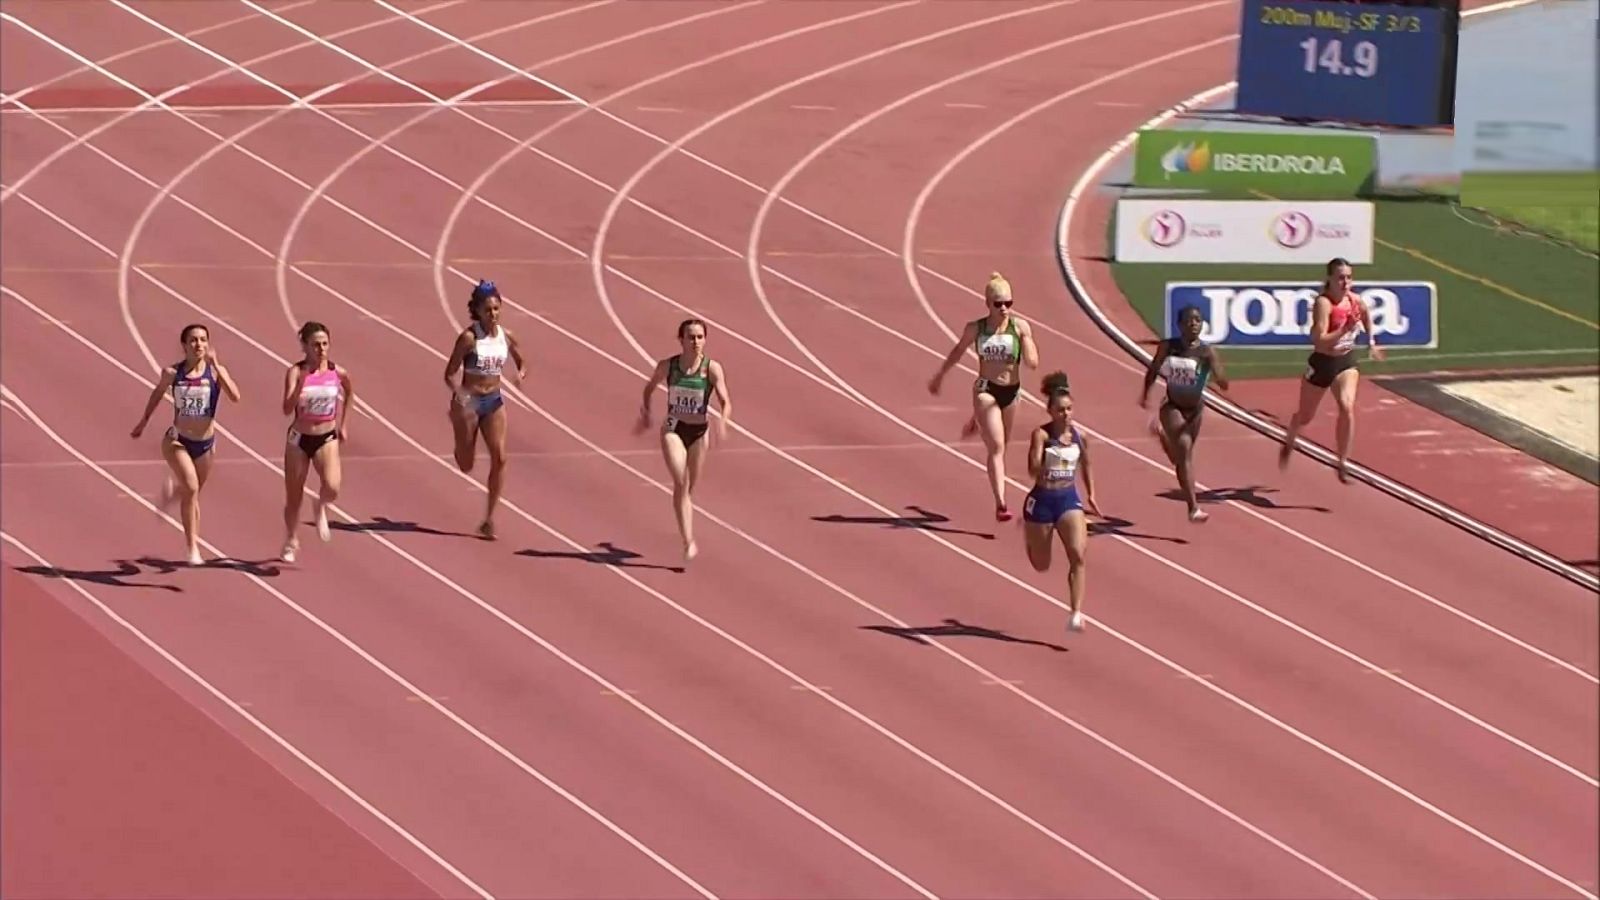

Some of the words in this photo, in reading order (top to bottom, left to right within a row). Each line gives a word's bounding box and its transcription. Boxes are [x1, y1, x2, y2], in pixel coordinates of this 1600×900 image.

[1261, 6, 1312, 26] 200m
[1299, 37, 1378, 77] 14.9
[1213, 153, 1346, 175] IBERDROLA
[180, 397, 204, 409] 328
[676, 395, 697, 407] 146
